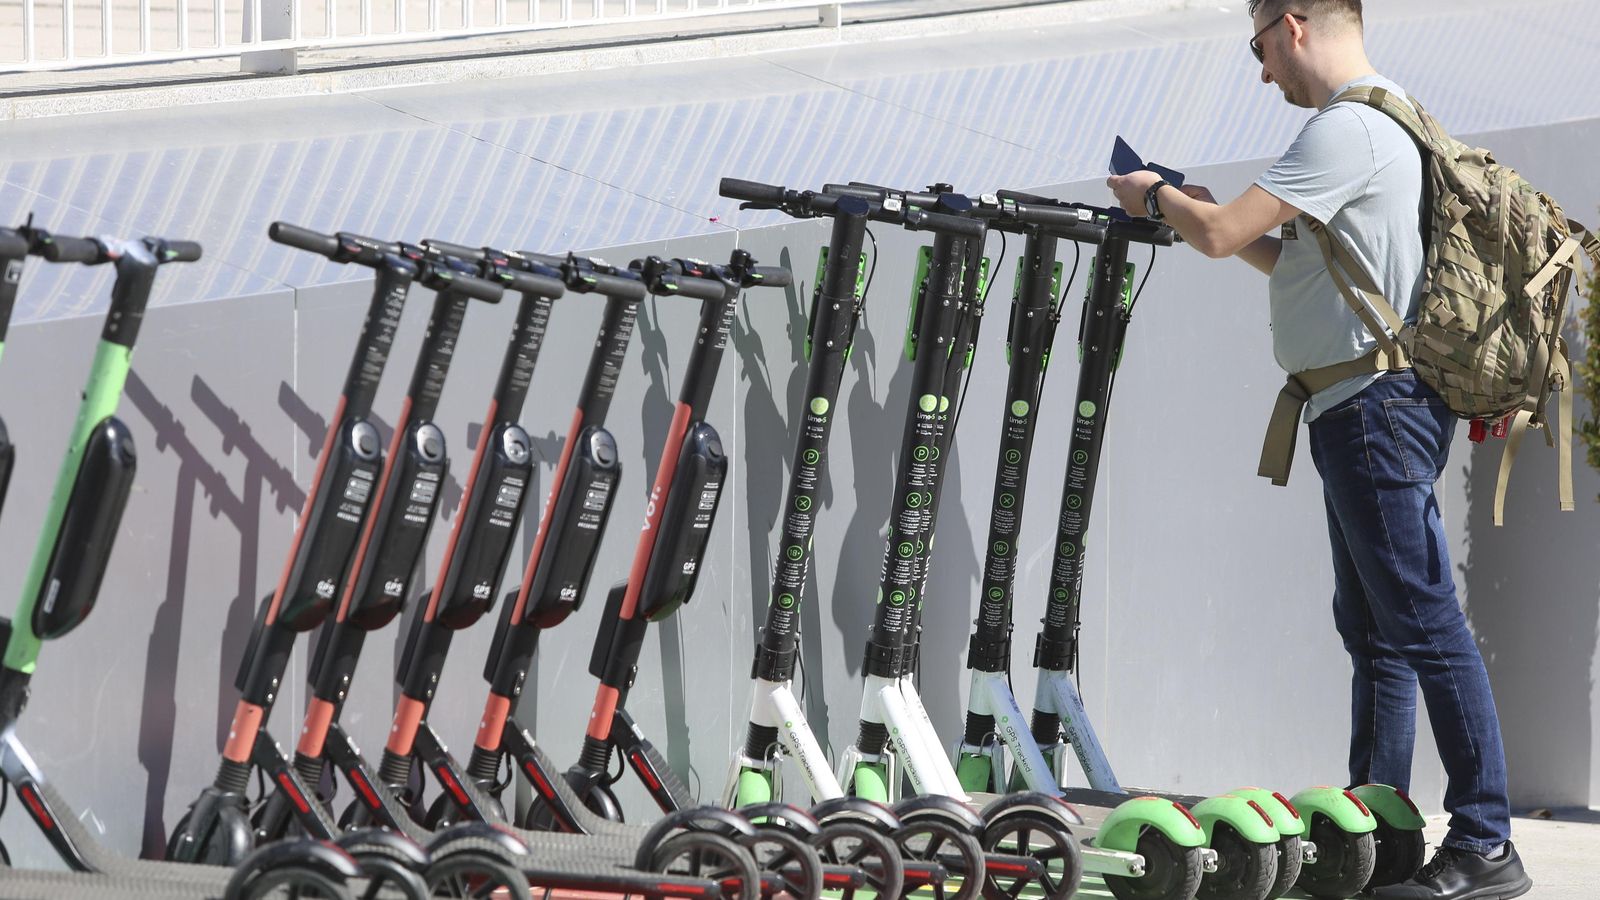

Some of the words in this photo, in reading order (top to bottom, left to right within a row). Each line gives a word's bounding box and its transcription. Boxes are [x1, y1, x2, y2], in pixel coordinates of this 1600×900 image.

[900, 546, 912, 554] 18+
[995, 544, 1006, 552] 18+
[683, 562, 696, 571] GPS
[317, 580, 335, 594] GPS
[384, 581, 403, 592] GPS
[474, 584, 491, 595] GPS
[560, 587, 577, 598] GPS
[790, 732, 801, 749] GPS
[1006, 726, 1018, 743] GPS
[1014, 742, 1032, 773] Tracked
[896, 737, 906, 753] GPS
[905, 755, 920, 786] Tracked
[1076, 743, 1093, 773] Tracked
